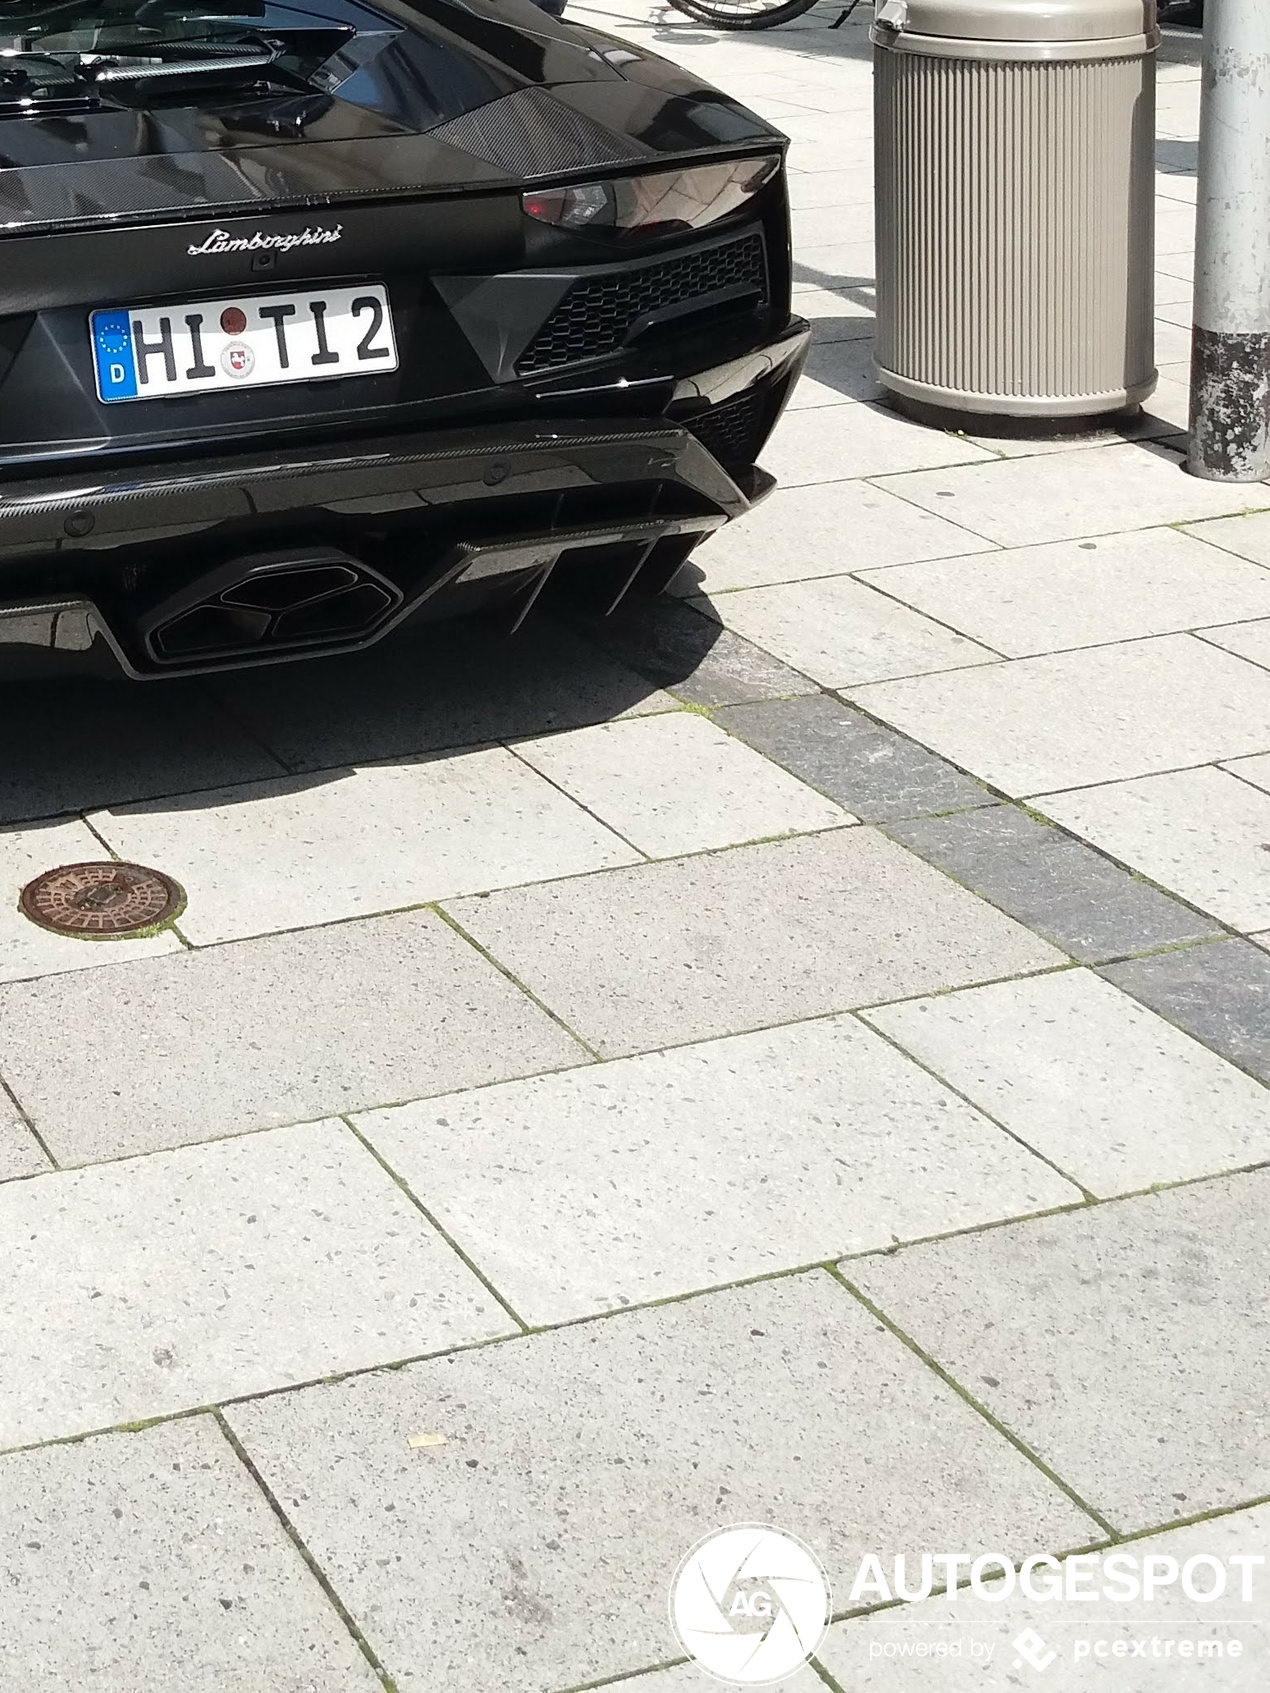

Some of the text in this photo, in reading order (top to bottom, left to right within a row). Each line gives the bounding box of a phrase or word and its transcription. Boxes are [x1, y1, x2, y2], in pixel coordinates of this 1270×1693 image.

[187, 223, 344, 256] Lamborghini
[132, 314, 216, 385] HI
[109, 363, 126, 384] D
